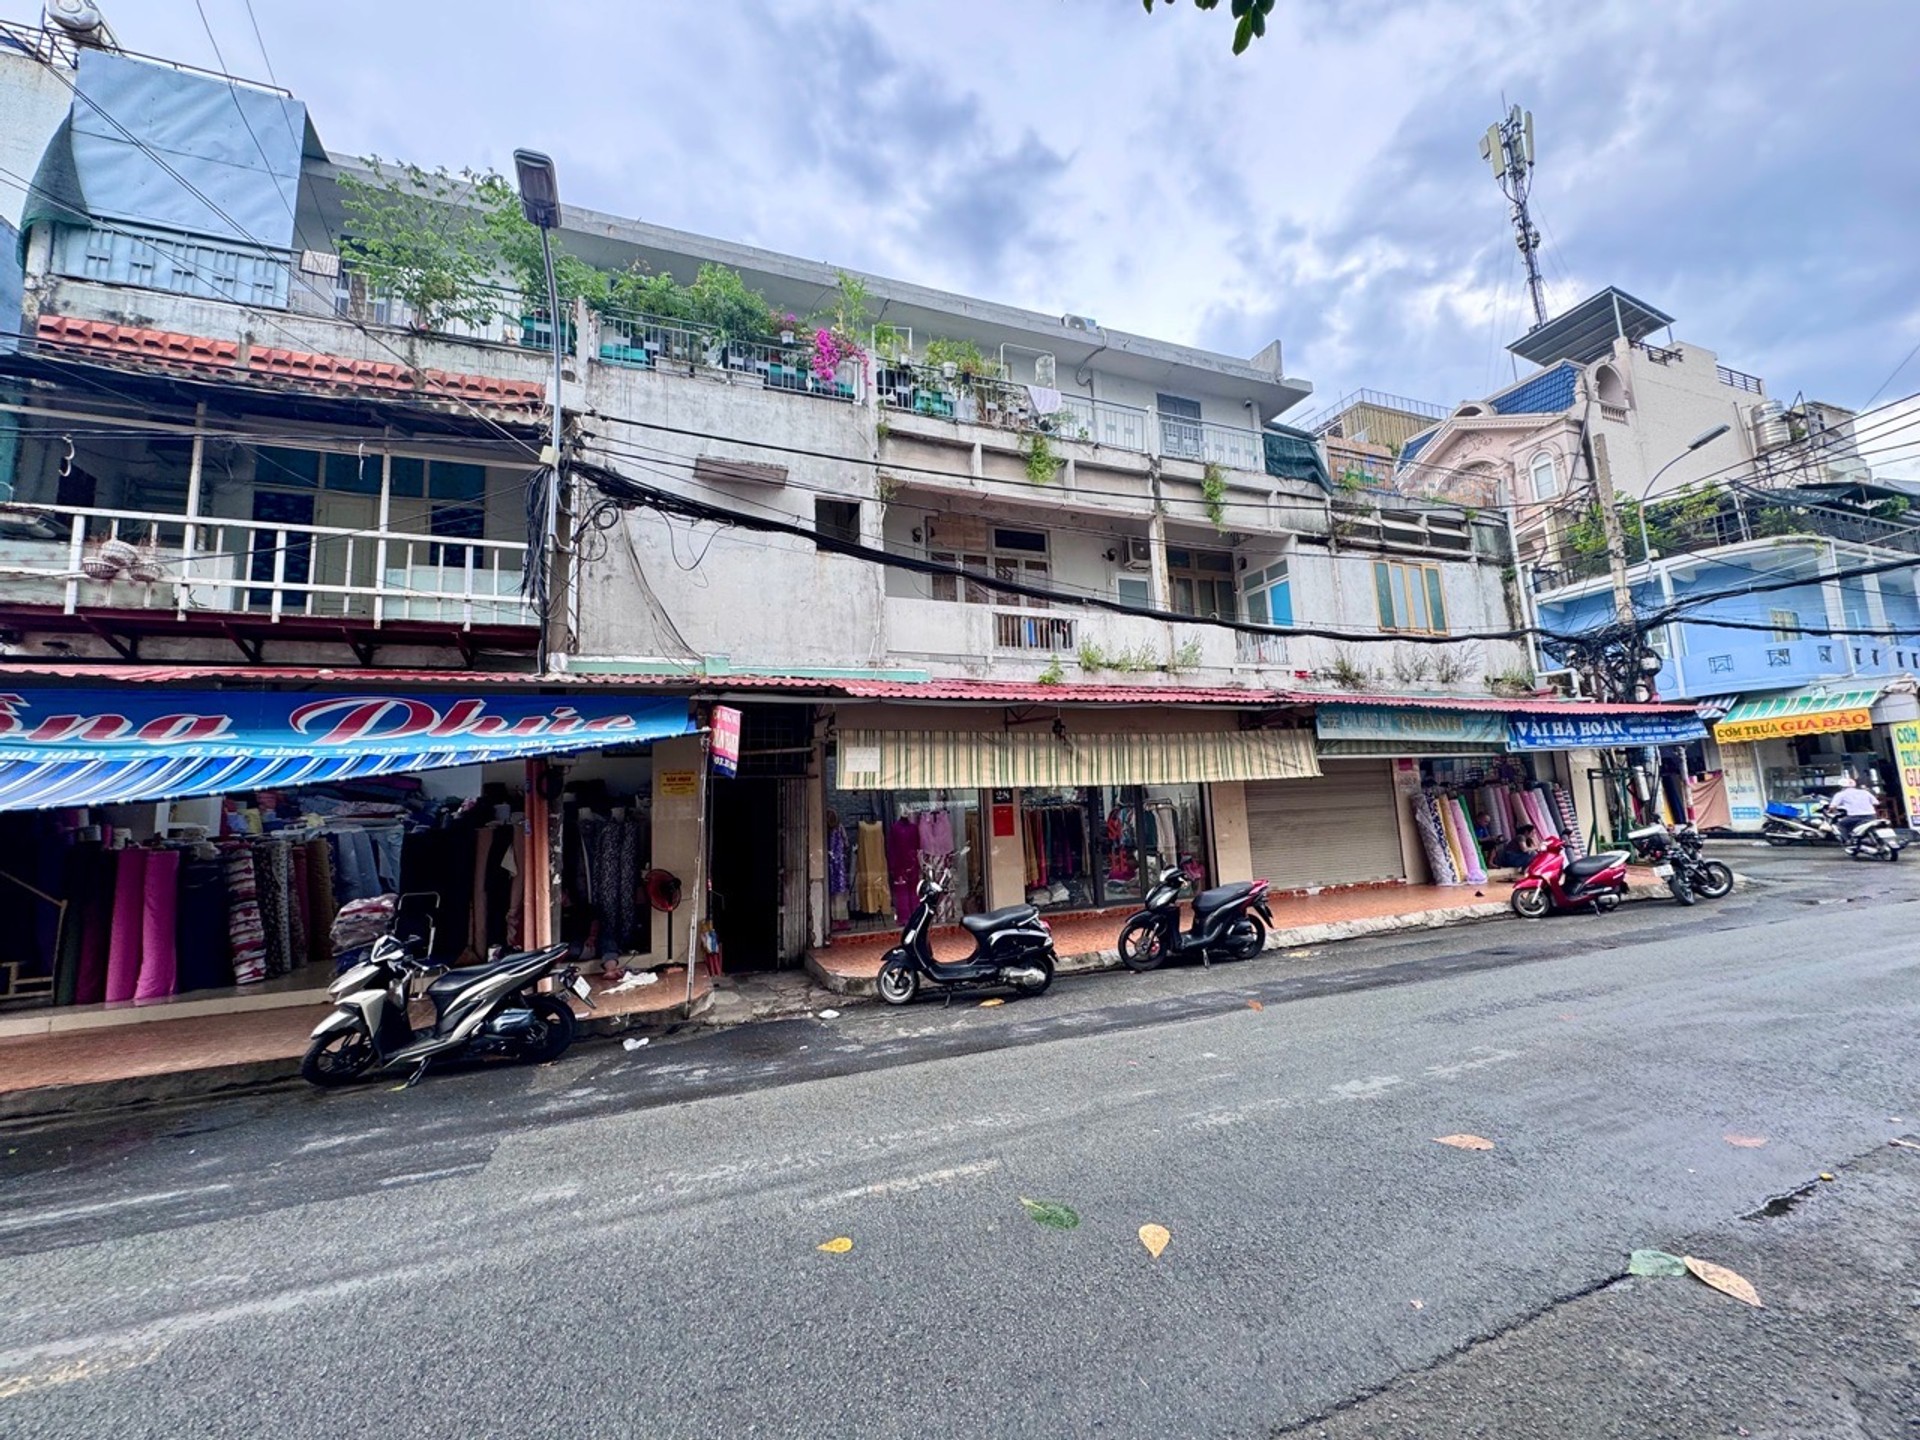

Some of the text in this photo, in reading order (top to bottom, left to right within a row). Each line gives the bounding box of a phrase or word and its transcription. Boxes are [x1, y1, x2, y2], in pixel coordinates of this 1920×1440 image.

[1717, 724, 1743, 738] CƠM
[1780, 719, 1819, 731] GIA
[1822, 712, 1868, 728] BẢO
